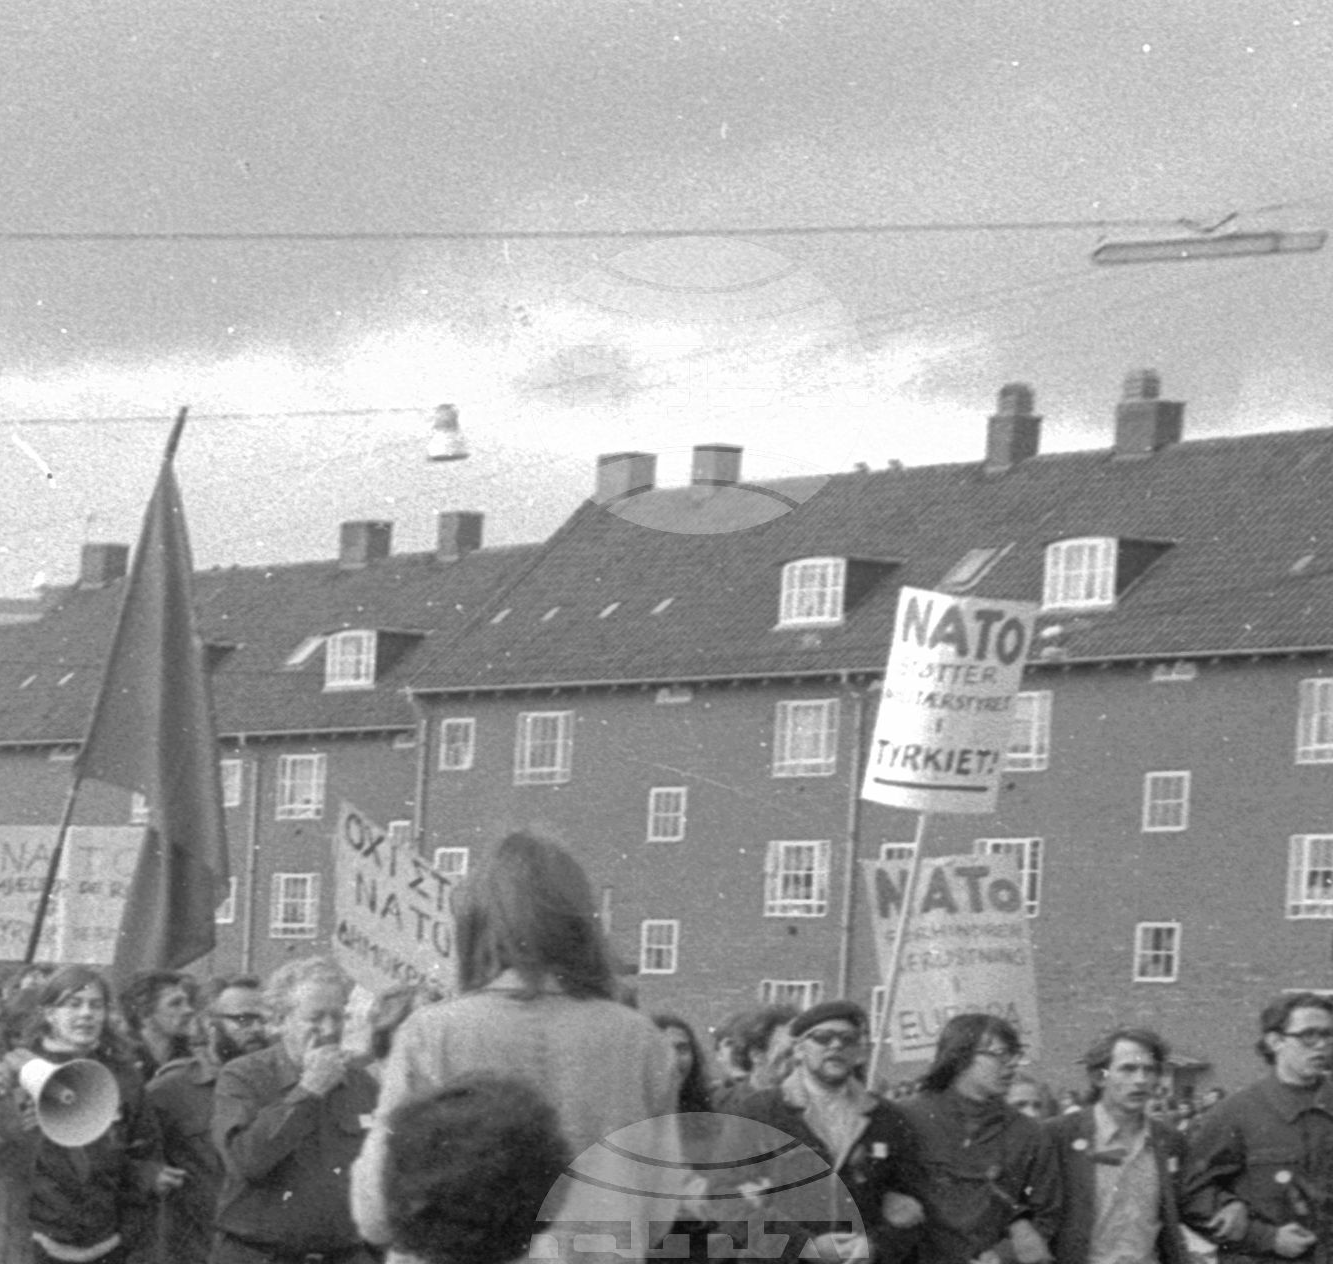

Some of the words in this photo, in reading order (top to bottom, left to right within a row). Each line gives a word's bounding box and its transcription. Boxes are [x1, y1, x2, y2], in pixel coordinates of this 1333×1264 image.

[902, 596, 1026, 665] NATO
[900, 658, 998, 684] ØTTER
[876, 739, 1000, 775] TYRKIET!
[875, 866, 1022, 918] NATO
[898, 1001, 1031, 1041] EUA
